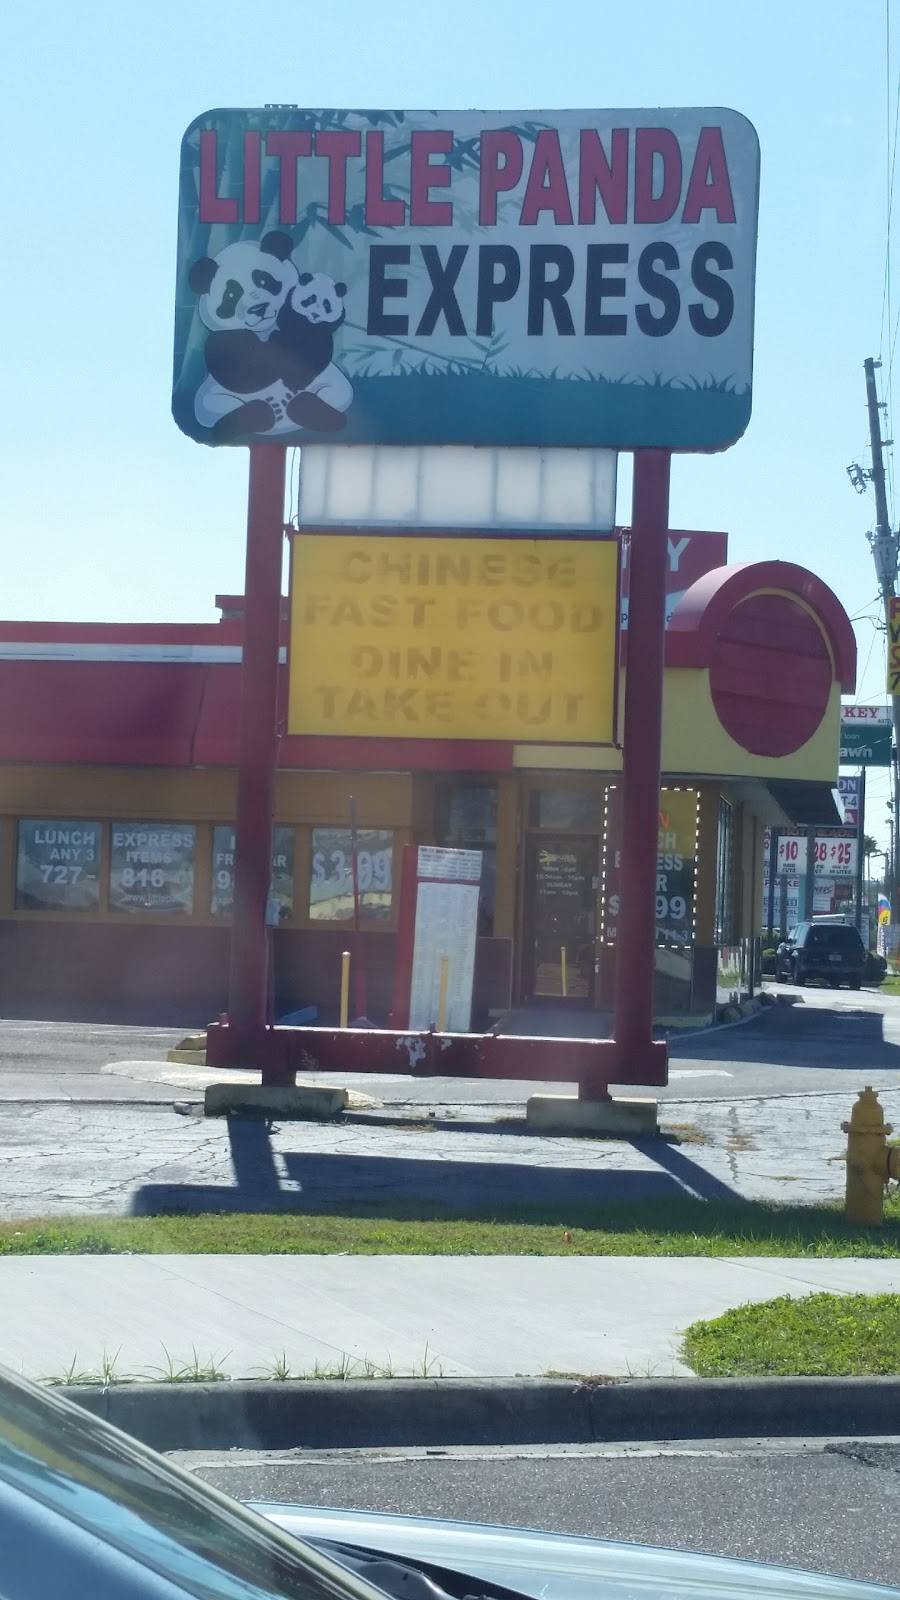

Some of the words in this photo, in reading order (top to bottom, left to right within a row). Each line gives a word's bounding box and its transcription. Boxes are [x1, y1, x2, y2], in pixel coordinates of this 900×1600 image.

[199, 129, 454, 226] LITTLE
[478, 126, 737, 226] PANDA
[366, 240, 735, 338] EXPRESS
[344, 551, 577, 588] CHINESE
[304, 594, 435, 629] FAST
[457, 598, 603, 634] FOOD
[351, 644, 478, 682] DINE
[500, 650, 553, 682] IN
[317, 686, 456, 722] TAKE
[479, 692, 584, 725] OUT
[839, 747, 873, 758] awn
[34, 830, 96, 845] LUNCH
[113, 832, 194, 848] EXPRESS
[50, 848, 81, 861] ANY
[86, 849, 95, 861] 3
[126, 850, 172, 864] ITEMS
[40, 865, 83, 885] 727
[312, 850, 390, 891] $399
